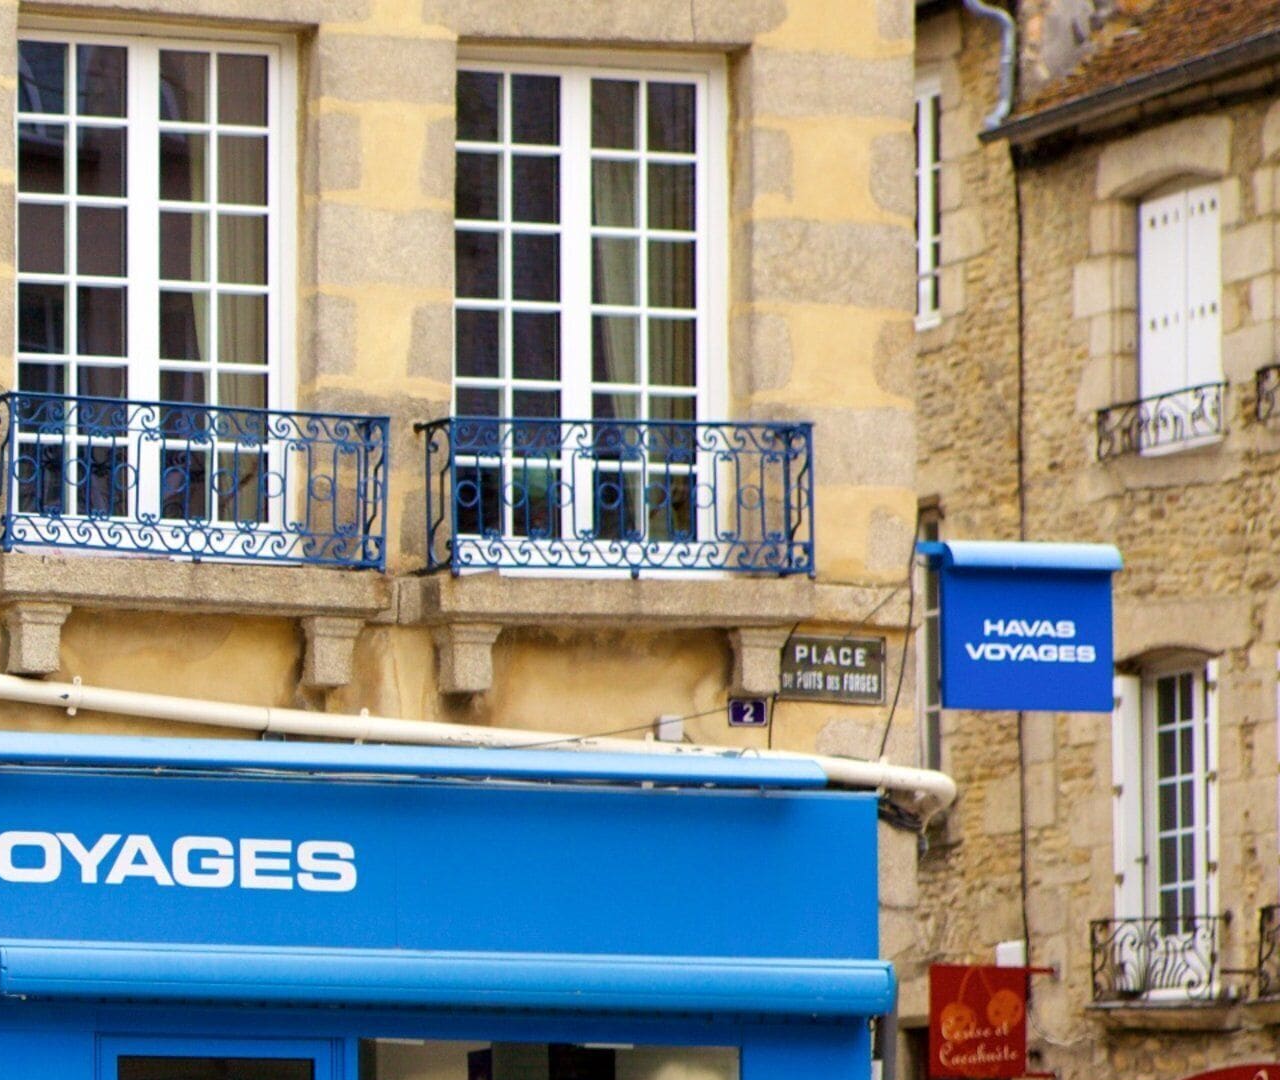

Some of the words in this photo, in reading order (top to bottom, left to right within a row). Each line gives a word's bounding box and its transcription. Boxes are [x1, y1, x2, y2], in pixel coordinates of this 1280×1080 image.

[983, 618, 1076, 639] HAVAS
[795, 644, 866, 667] PLACE
[965, 642, 1096, 663] VOYAGES
[797, 670, 823, 690] PUITS
[843, 673, 878, 693] FORGES
[742, 703, 755, 723] 2
